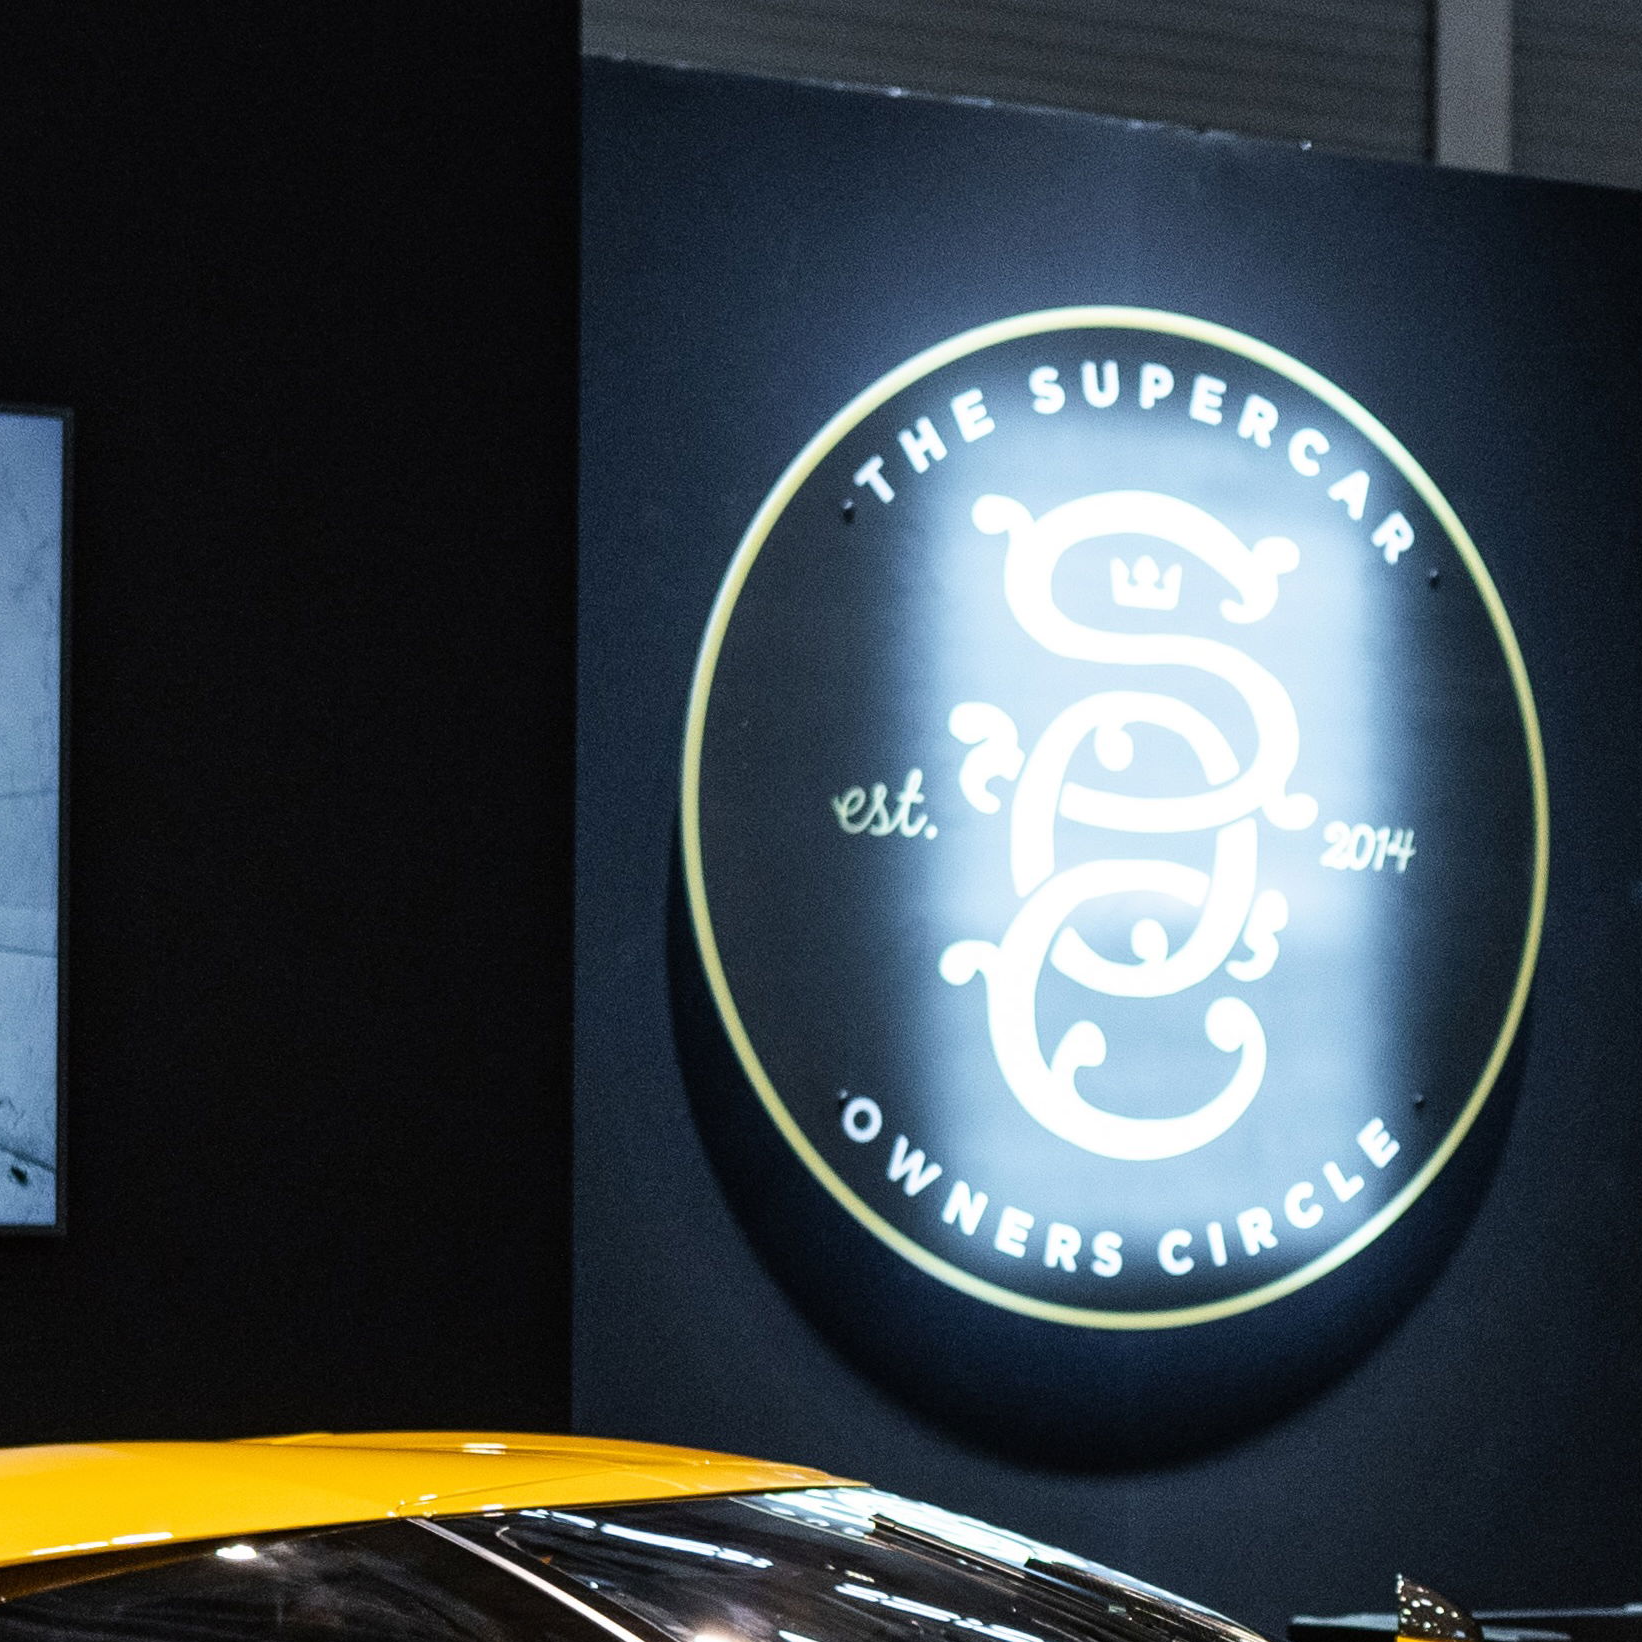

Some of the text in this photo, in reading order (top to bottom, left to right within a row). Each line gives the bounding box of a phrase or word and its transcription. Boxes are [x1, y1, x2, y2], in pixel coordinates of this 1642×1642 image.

[853, 358, 1416, 566] THE SUPERCAR
[830, 767, 939, 841] est.
[1319, 820, 1418, 874] 2014
[840, 1095, 1401, 1279] OWNERS CIRCLE
